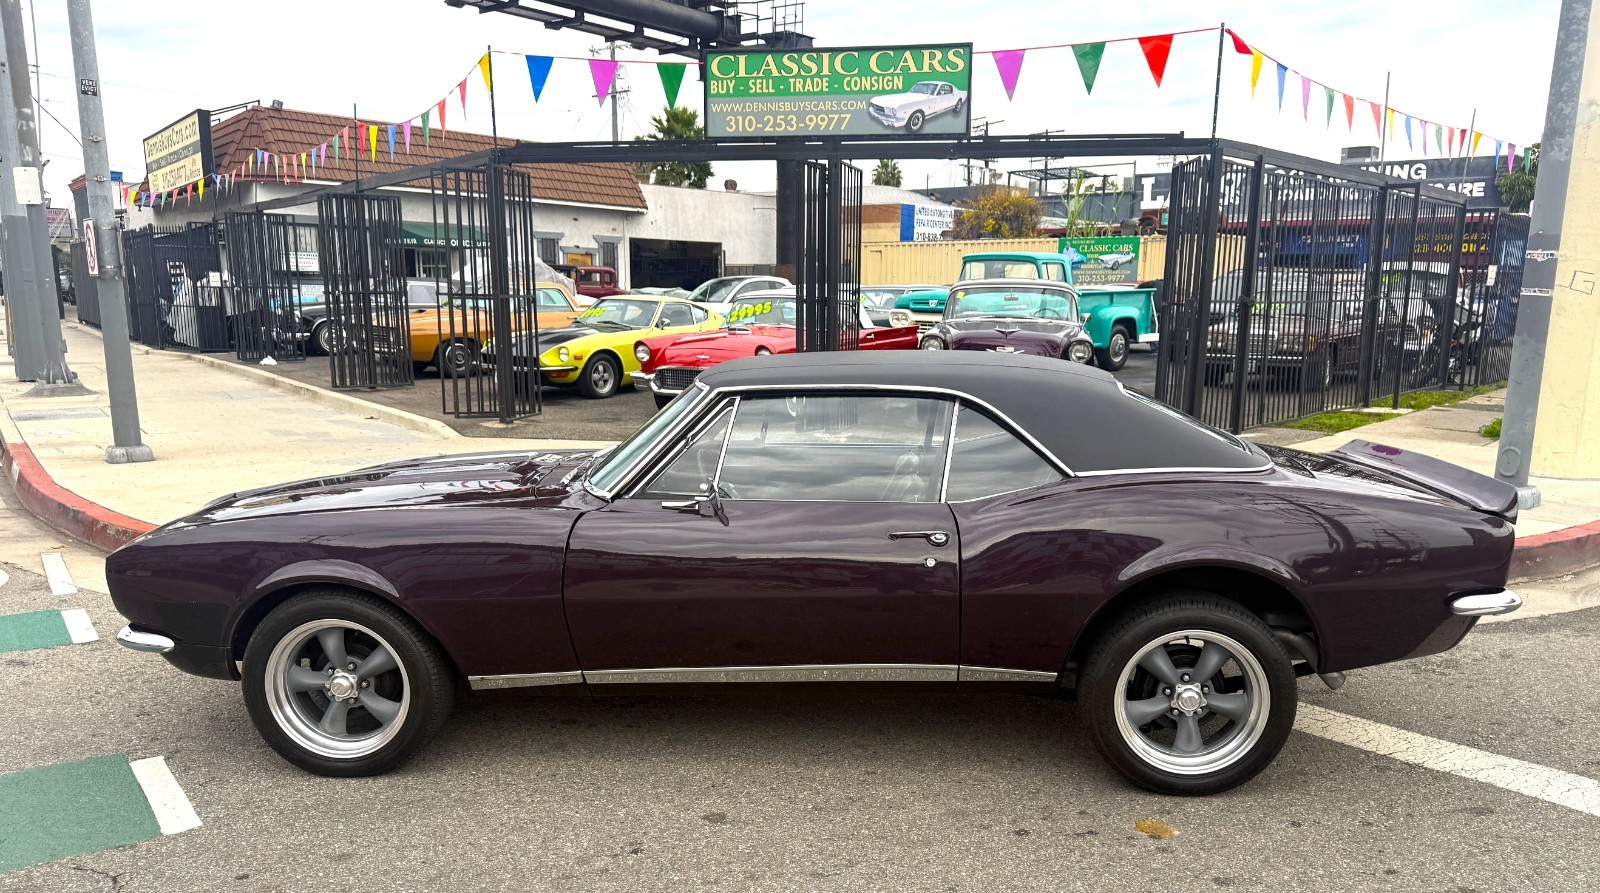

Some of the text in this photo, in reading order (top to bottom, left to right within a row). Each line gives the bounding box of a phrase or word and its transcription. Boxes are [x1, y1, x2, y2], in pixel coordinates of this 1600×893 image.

[710, 48, 965, 78] CLASSIC CARS
[710, 79, 735, 94] BUY
[748, 79, 775, 93] SELL
[788, 78, 829, 92] TRADE
[843, 75, 903, 91] CONSIGN
[711, 101, 866, 112] WWW.DENNISBUYSCARS.COM
[725, 113, 852, 132] 310-253-9977
[1079, 243, 1133, 252] CLASSIC CARS
